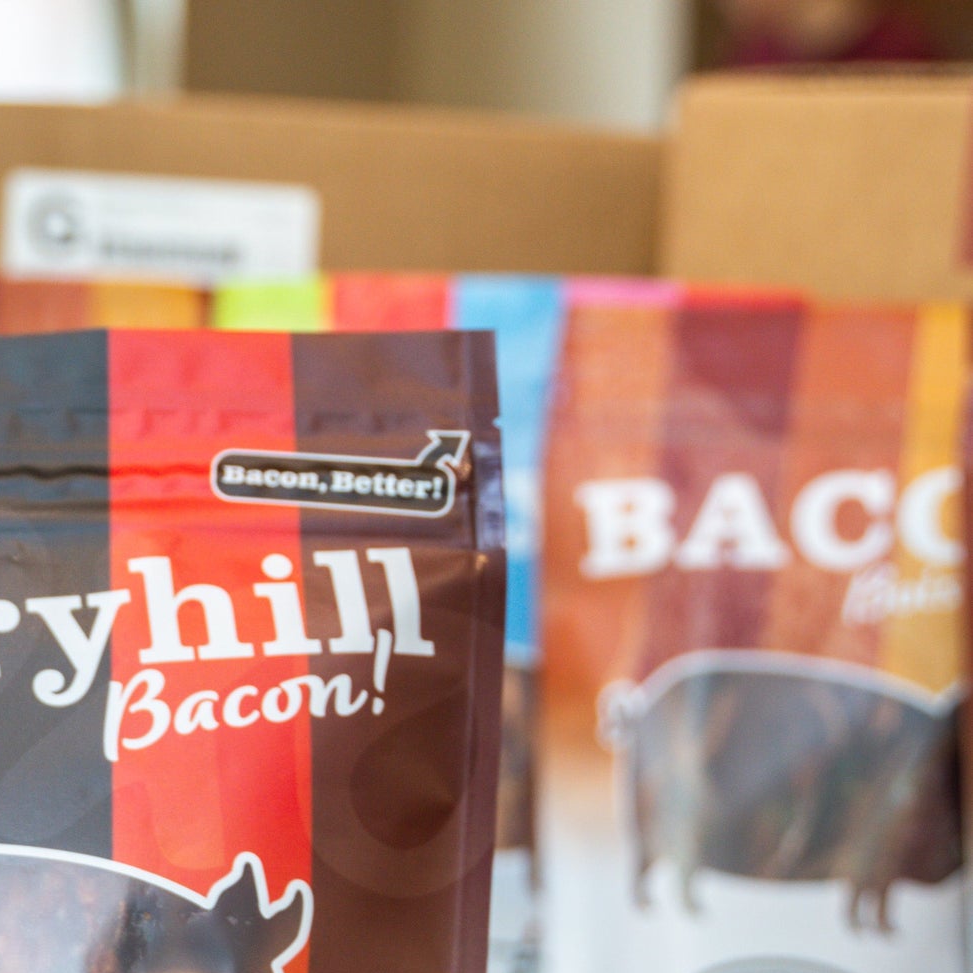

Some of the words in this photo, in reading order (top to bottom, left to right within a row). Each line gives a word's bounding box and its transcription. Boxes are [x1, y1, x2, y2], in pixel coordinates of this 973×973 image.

[222, 462, 328, 494] Bacon,
[330, 468, 445, 502] Better!
[103, 628, 391, 761] Bacon!
